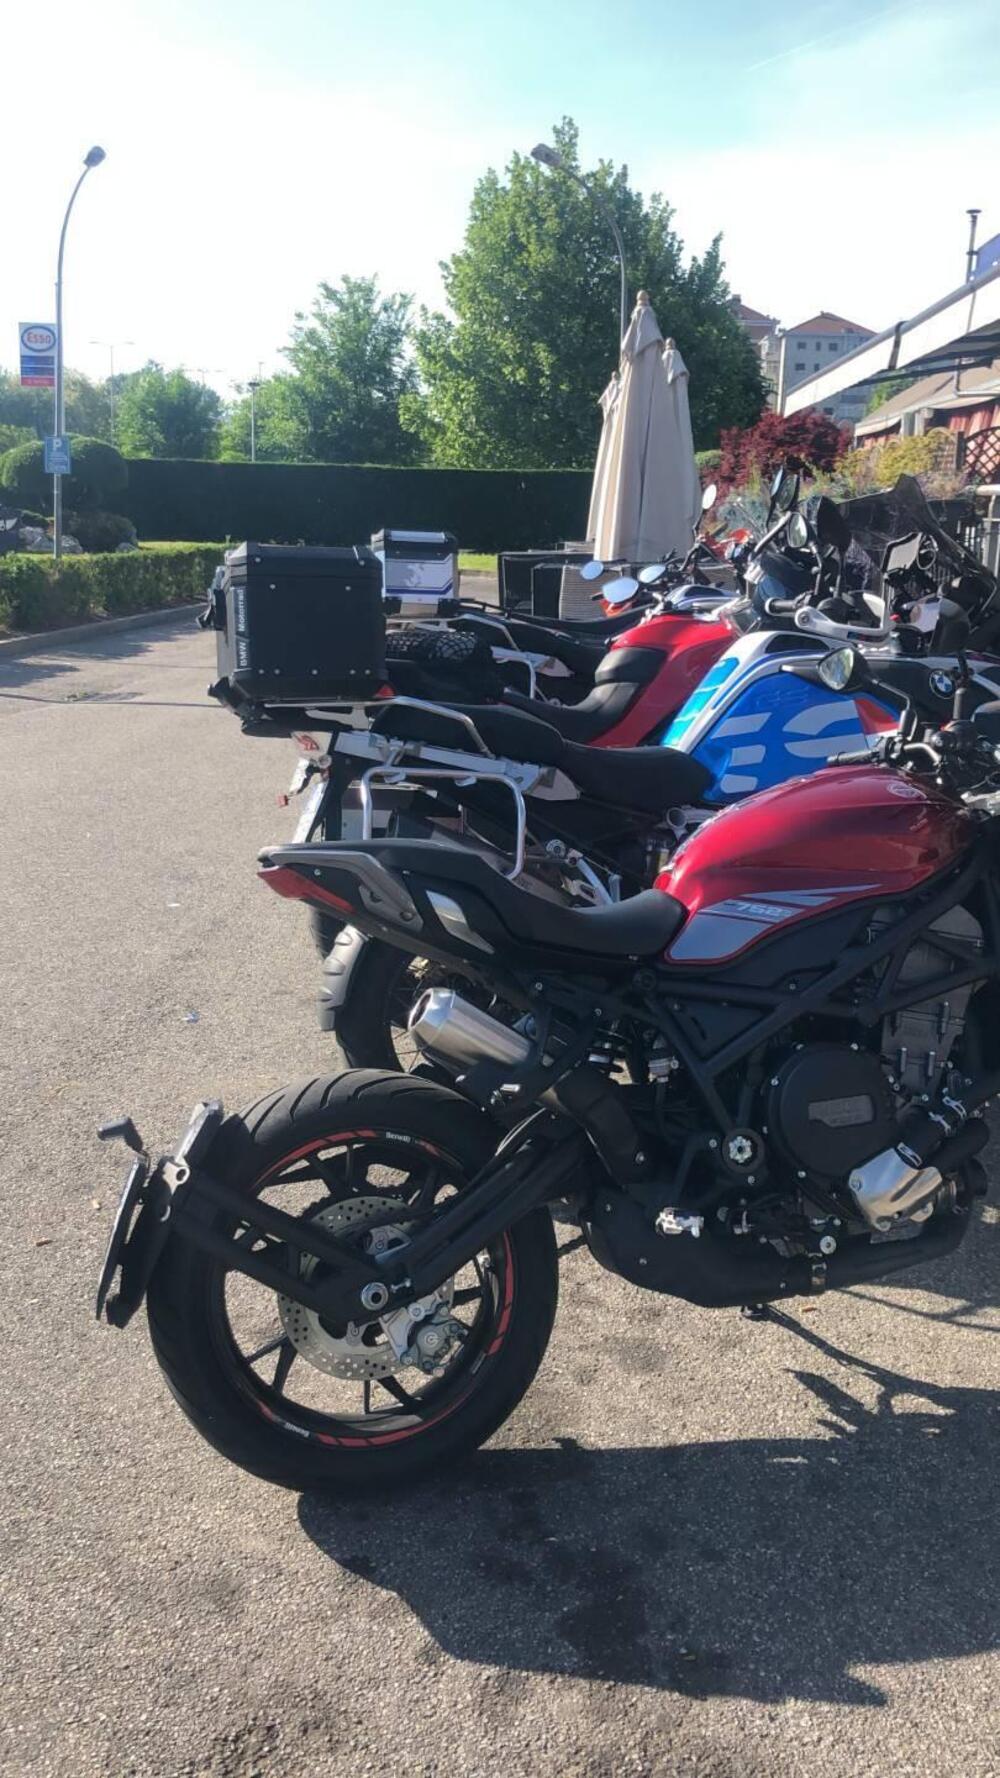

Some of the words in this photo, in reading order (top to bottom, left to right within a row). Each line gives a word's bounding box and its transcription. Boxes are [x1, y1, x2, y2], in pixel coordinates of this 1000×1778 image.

[53, 439, 62, 451] P
[237, 589, 246, 632] Motorrad
[240, 641, 248, 667] BMW
